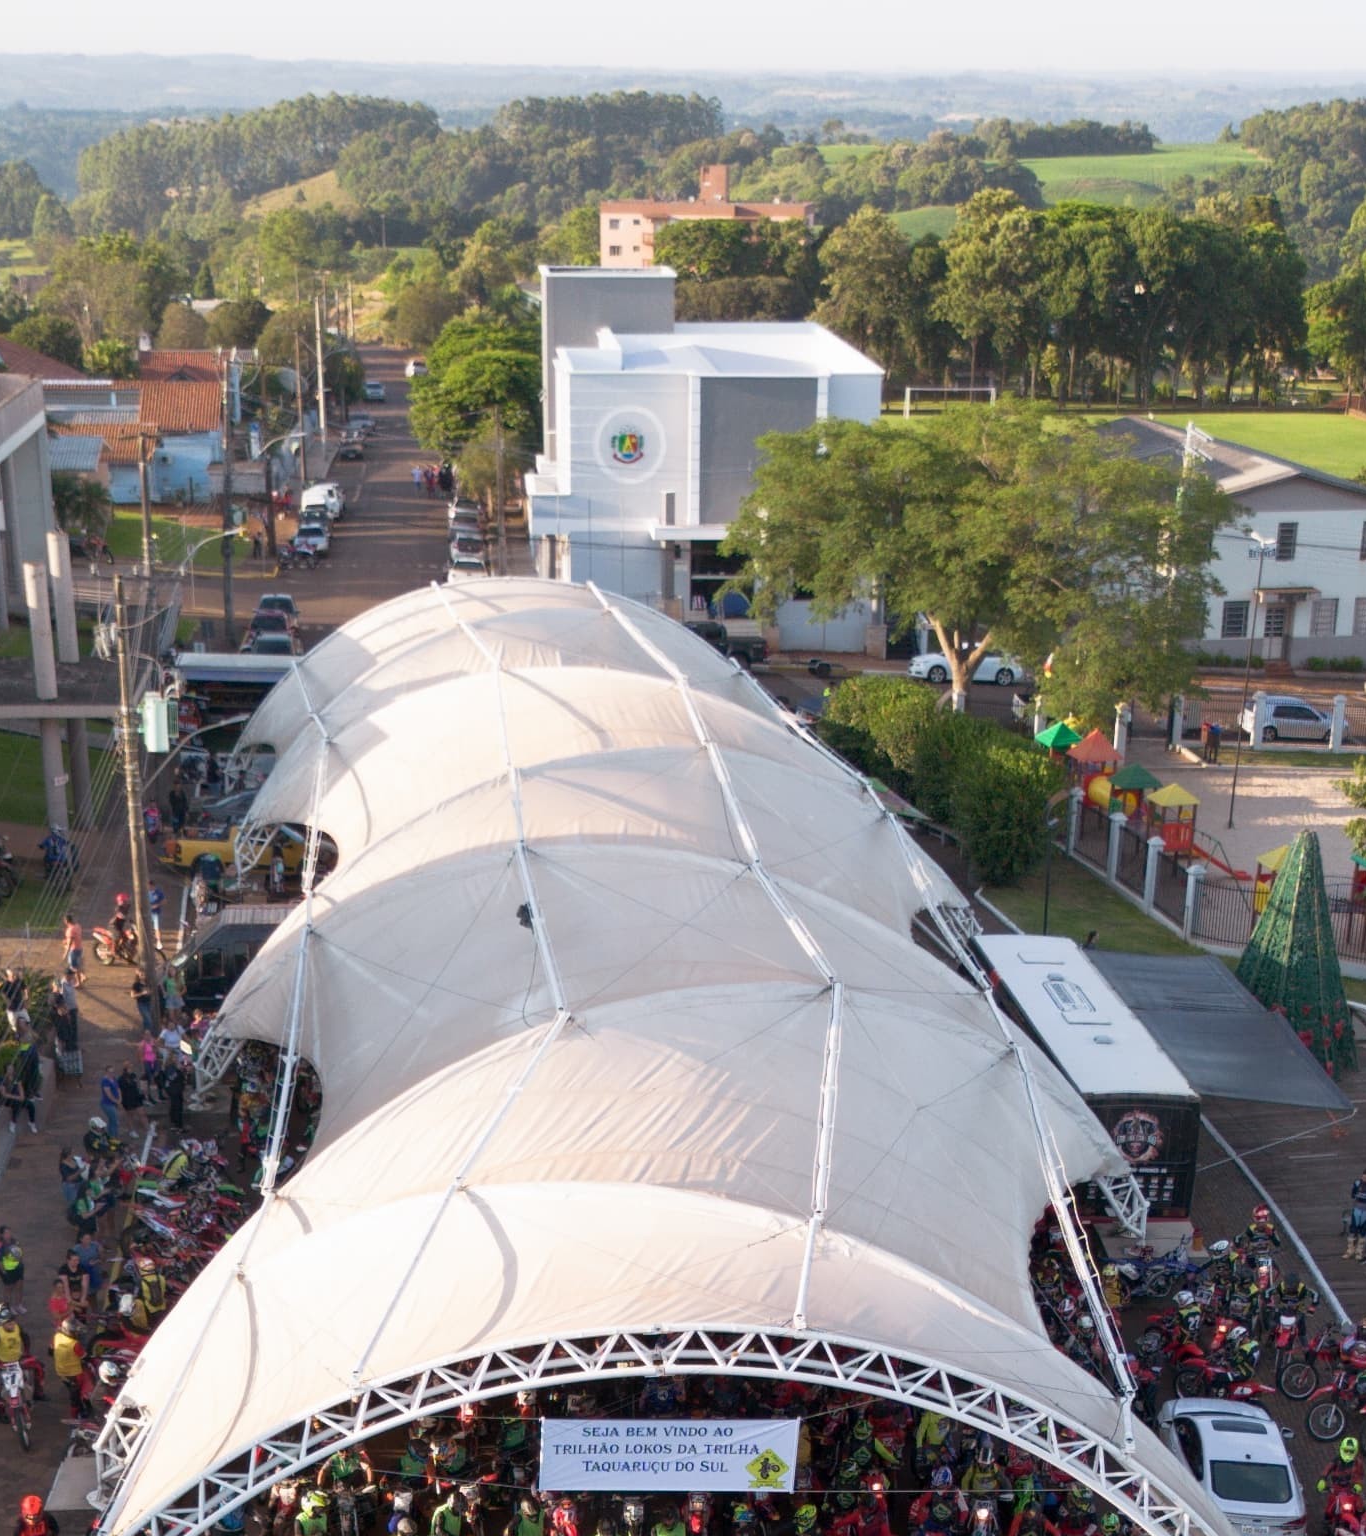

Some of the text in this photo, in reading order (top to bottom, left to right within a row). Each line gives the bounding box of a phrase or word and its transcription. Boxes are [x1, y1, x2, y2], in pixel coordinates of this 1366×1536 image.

[582, 1425, 734, 1438] SEJA BEM VINDO AO
[553, 1442, 761, 1455] TRILHÃO LOKOS DA TRILHA
[582, 1460, 729, 1475] TAQUARUÇU DO SUL
